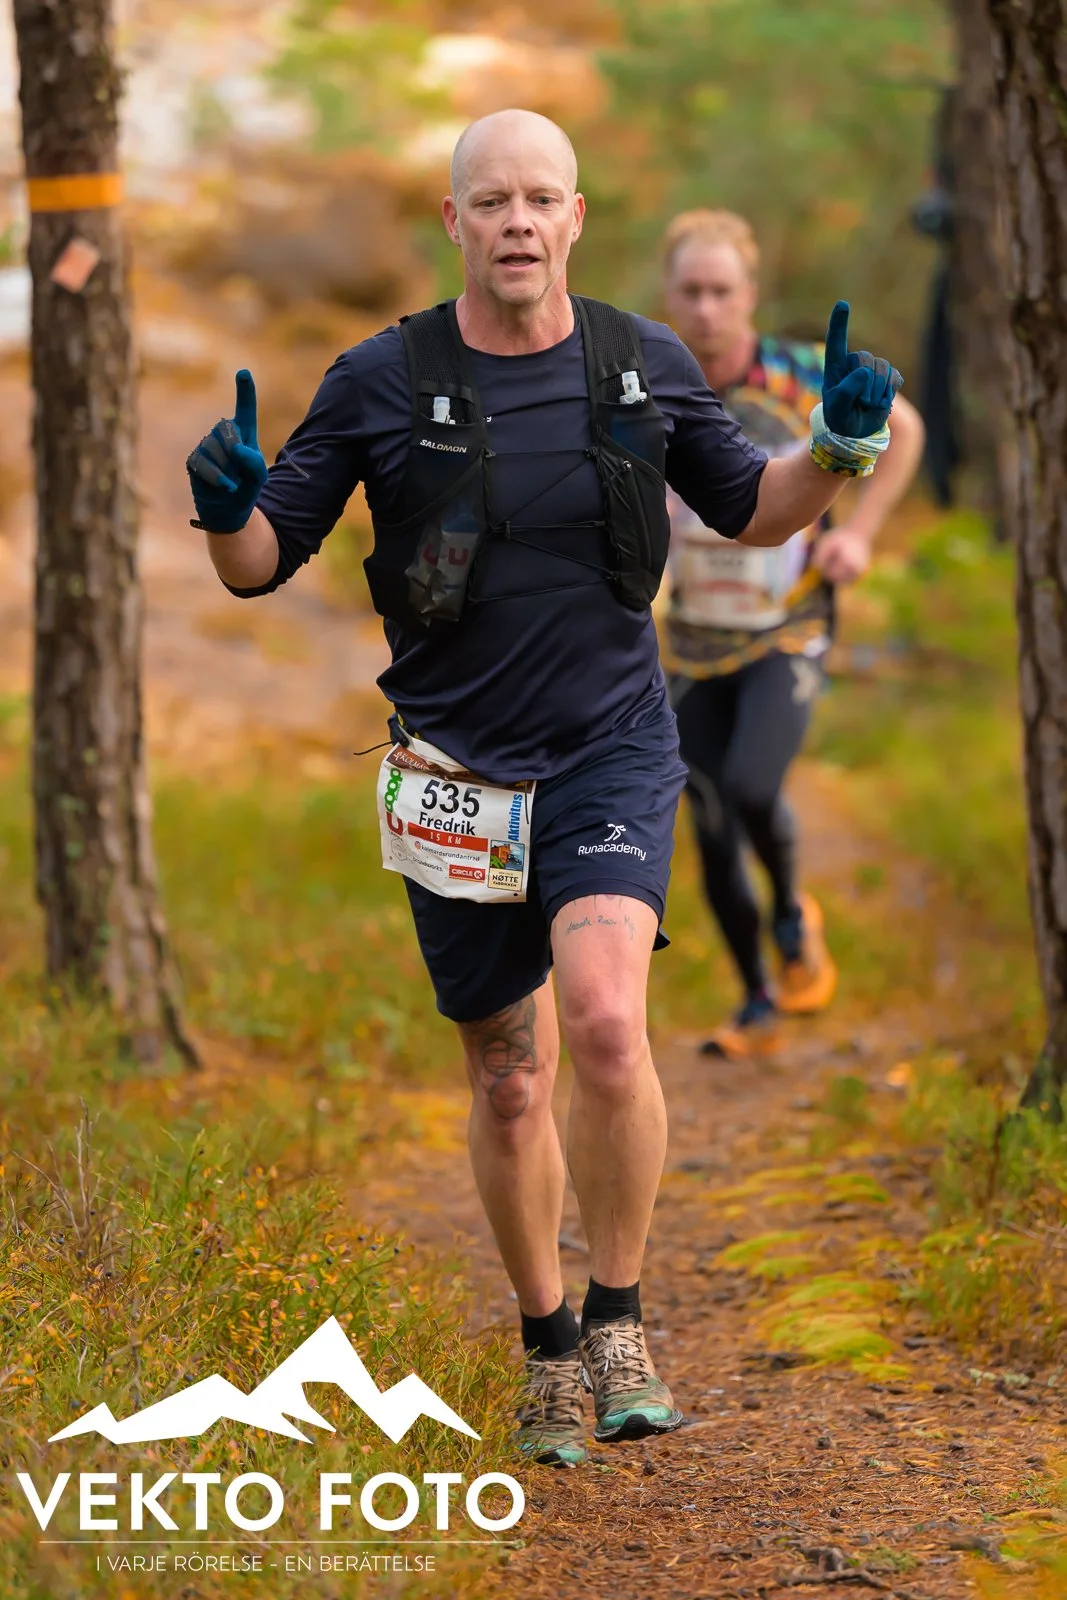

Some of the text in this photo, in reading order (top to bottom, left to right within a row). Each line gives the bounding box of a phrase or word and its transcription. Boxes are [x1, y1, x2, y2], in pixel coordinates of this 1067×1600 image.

[420, 439, 467, 453] SALOMON
[421, 779, 482, 818] 535
[418, 811, 476, 836] Fredrik
[507, 792, 523, 842] Aktivitus
[430, 831, 462, 845] 15 KM
[578, 842, 647, 861] Runacademy
[451, 868, 473, 876] CIRCLE
